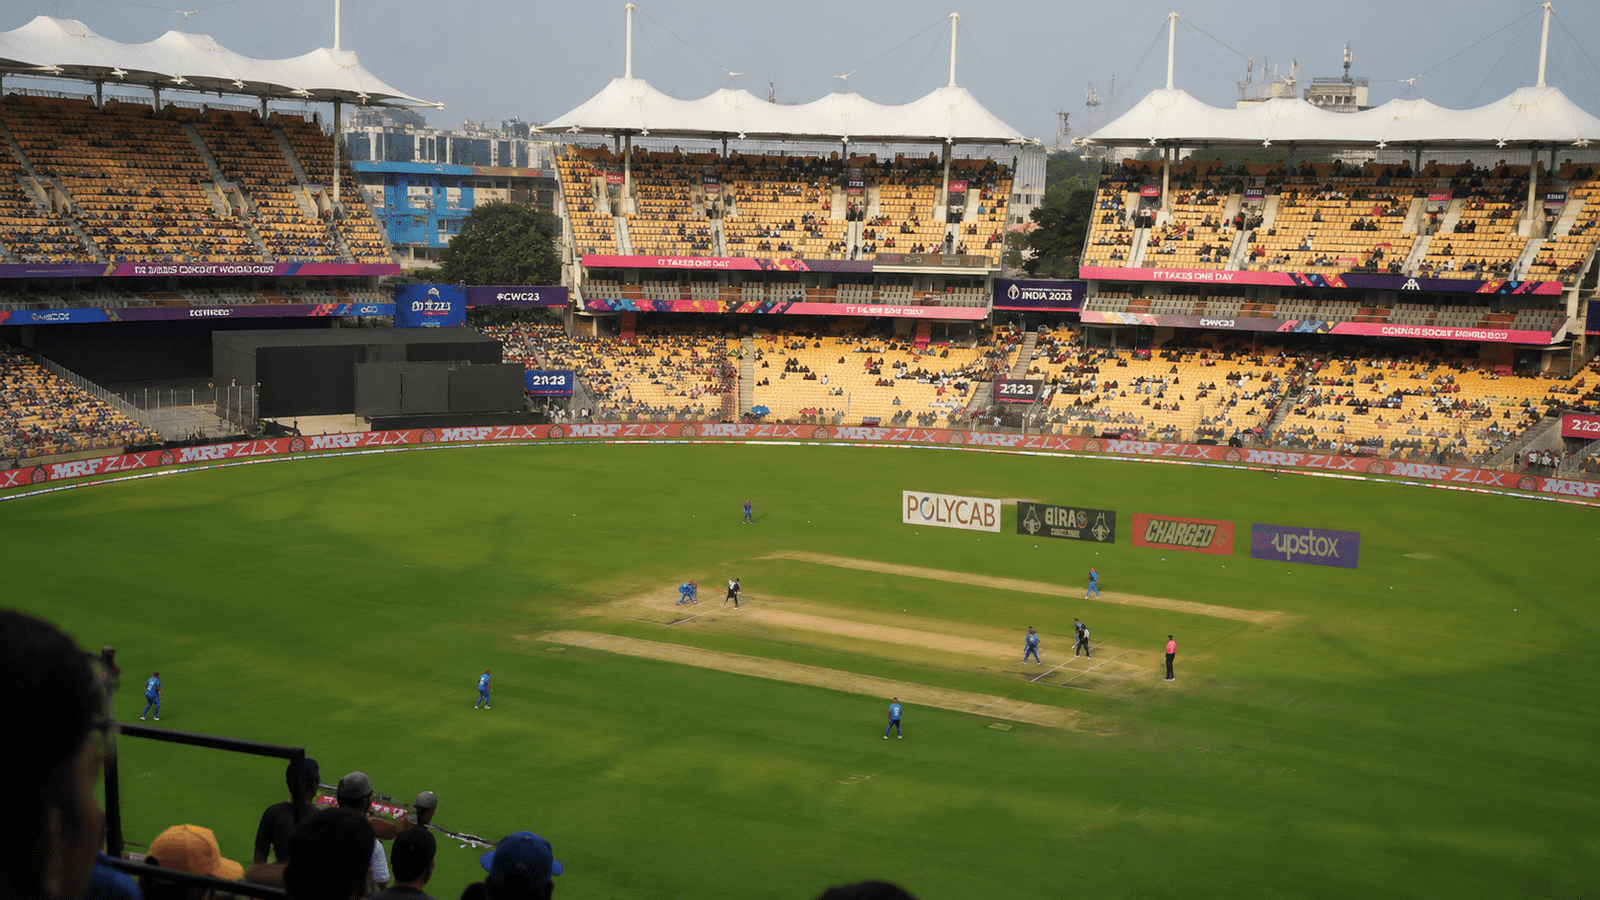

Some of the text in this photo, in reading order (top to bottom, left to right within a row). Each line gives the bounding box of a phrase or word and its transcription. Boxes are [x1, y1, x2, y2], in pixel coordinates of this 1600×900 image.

[1215, 273, 1234, 281] DAY
[496, 292, 540, 302] #CWC23
[310, 431, 410, 450] MRF ZLX
[440, 426, 537, 442] MRF ZLX
[569, 424, 668, 437] MRF ZLX
[701, 424, 799, 437] MRF ZLX
[834, 426, 936, 443] MRF ZLX
[969, 431, 1071, 450] MRF ZLX
[180, 440, 278, 463] MRF ZLX
[1105, 438, 1211, 459] MRF ZLX
[51, 454, 147, 480] MRF ZLX
[1245, 449, 1356, 470] MRF ZLX
[1390, 461, 1505, 486] MRF ZLX
[1542, 477, 1600, 498] MRF
[907, 494, 996, 527] POLYCAB
[1144, 519, 1218, 549] CHARGED
[1271, 529, 1340, 561] upstox
